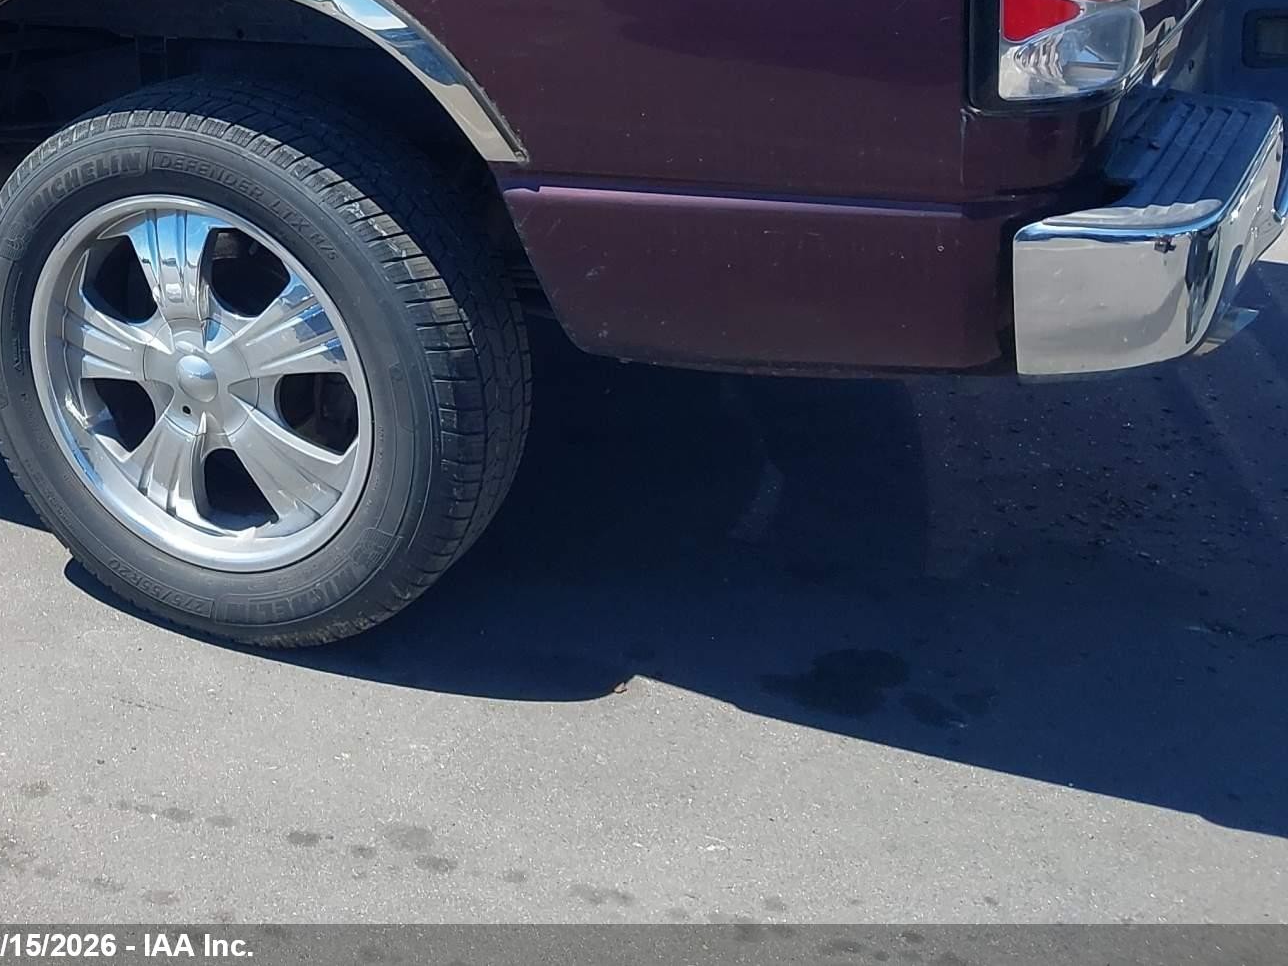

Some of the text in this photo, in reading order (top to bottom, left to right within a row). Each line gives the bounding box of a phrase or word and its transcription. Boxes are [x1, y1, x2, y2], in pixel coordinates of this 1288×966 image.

[158, 154, 265, 201] DEFENDER
[268, 198, 310, 231] LTX
[107, 558, 206, 612] 275/55R20
